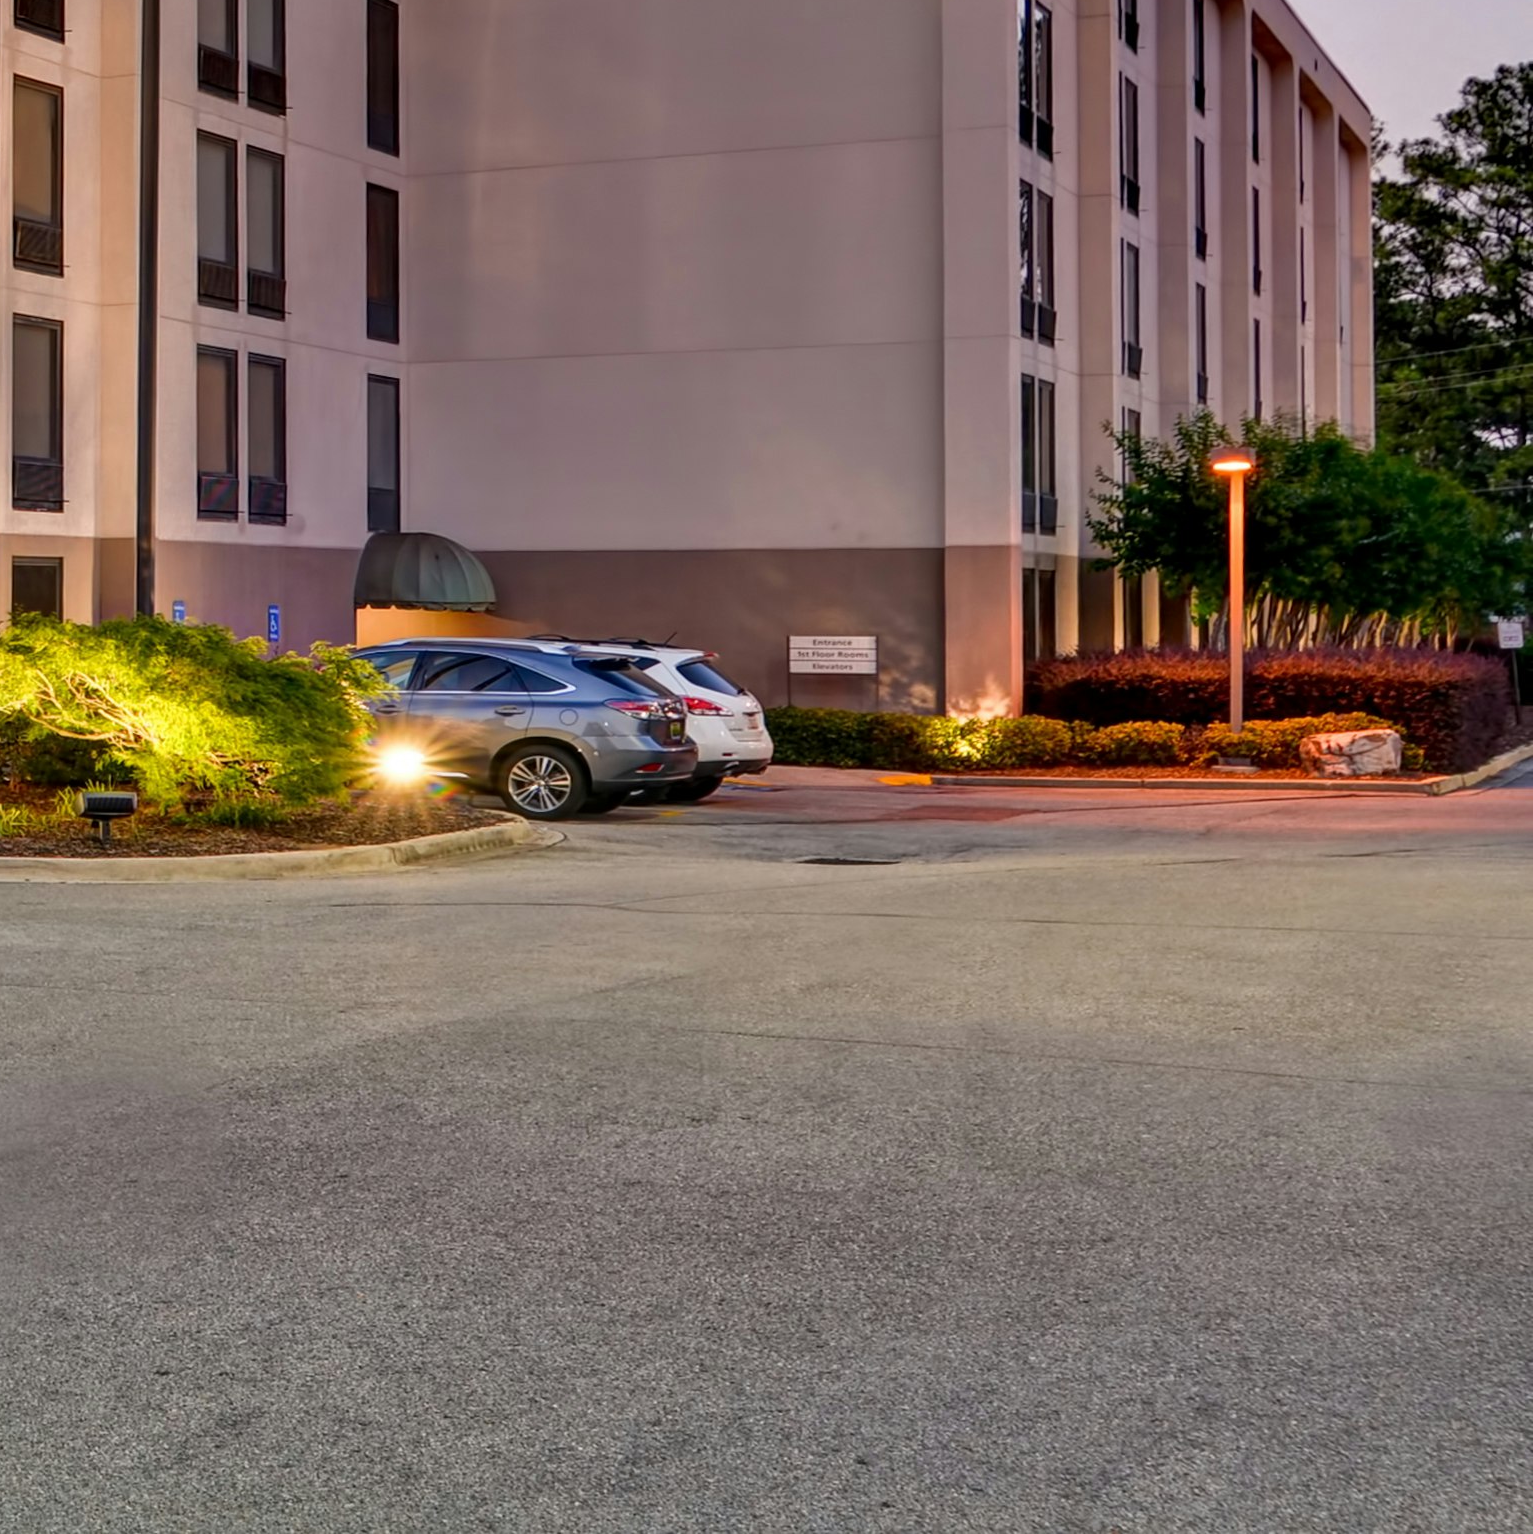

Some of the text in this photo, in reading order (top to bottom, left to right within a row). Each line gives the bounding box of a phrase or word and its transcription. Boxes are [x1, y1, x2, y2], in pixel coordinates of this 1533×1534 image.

[812, 638, 853, 647] Entrance
[797, 650, 870, 659] 1st Floor Rooms
[812, 662, 854, 671] Elevators
